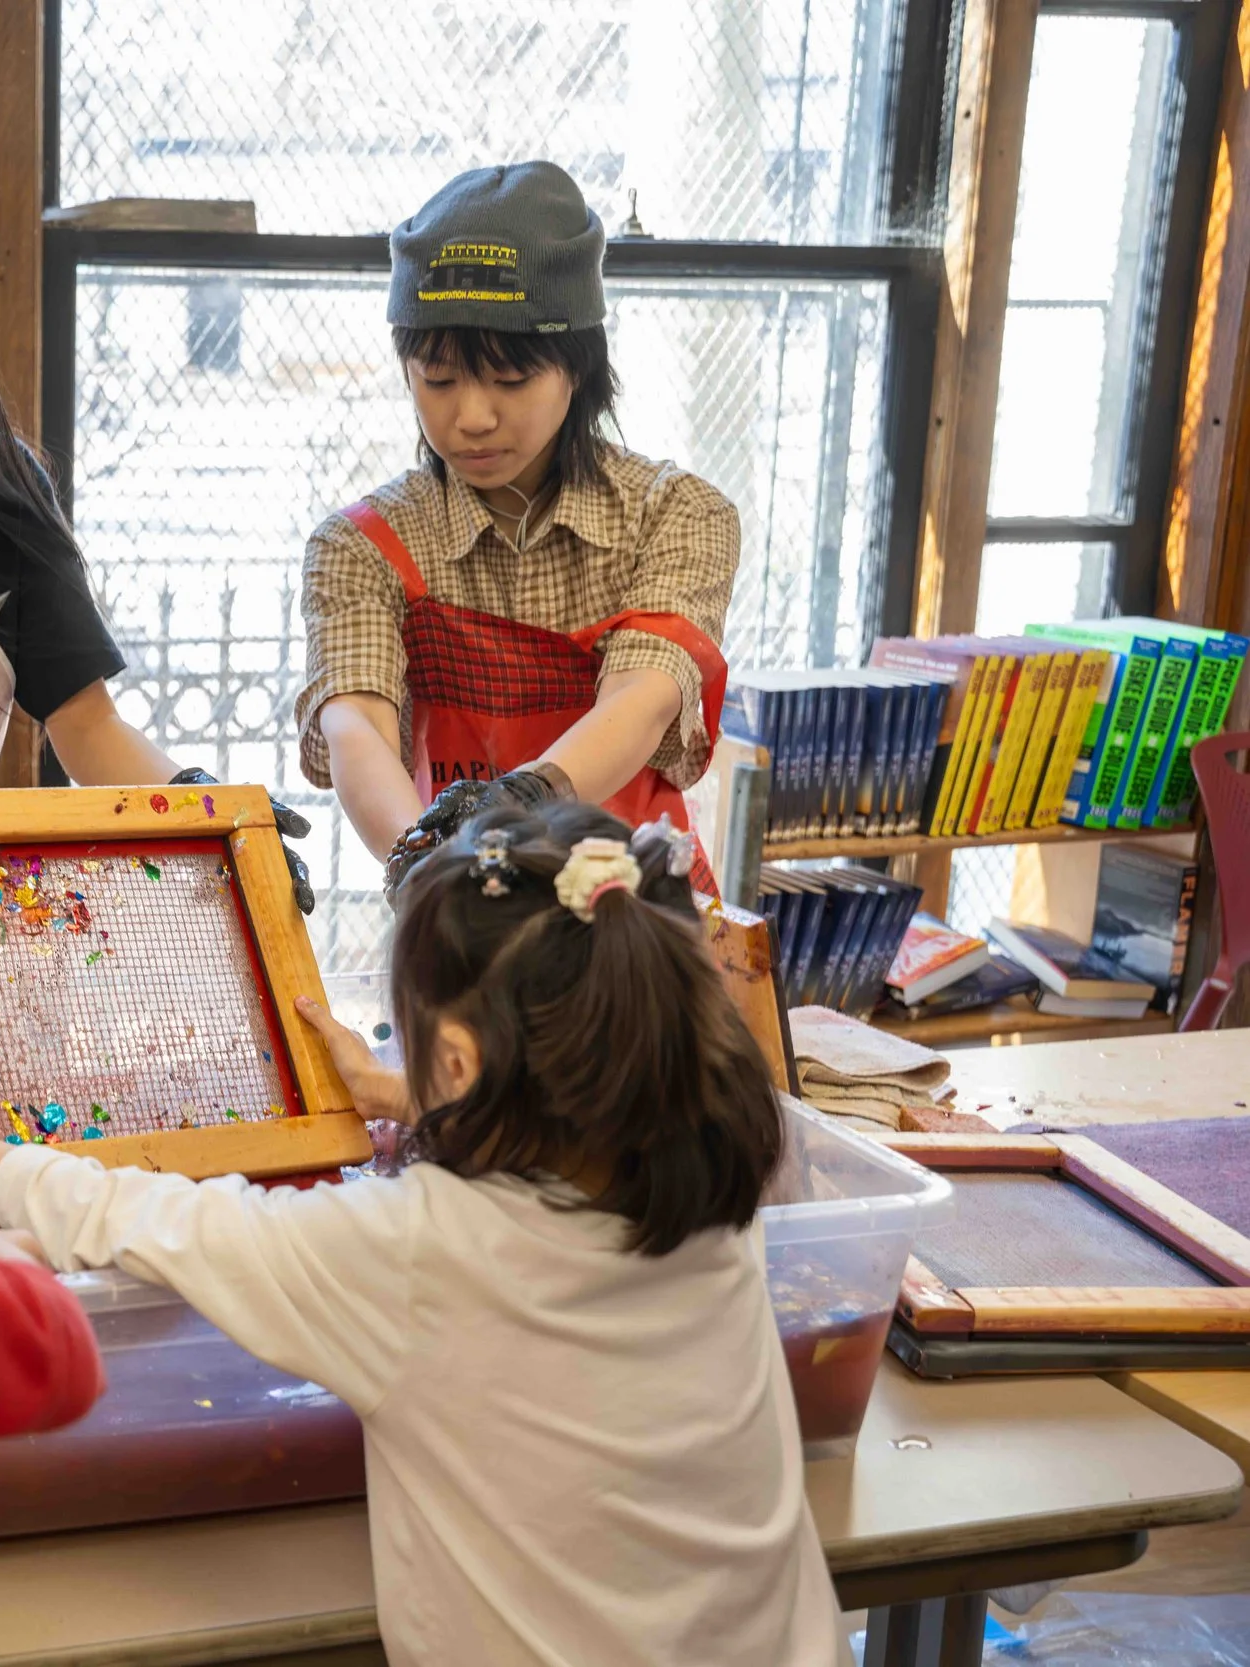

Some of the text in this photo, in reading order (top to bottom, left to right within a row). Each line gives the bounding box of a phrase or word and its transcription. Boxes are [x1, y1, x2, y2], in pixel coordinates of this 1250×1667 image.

[1124, 657, 1151, 695] FISKE
[1158, 658, 1186, 697] FISKE
[1195, 659, 1222, 697] FISKE
[1206, 658, 1239, 732] FISKE GUIDE
[1113, 696, 1139, 733] GUIDE
[1147, 697, 1174, 735] GUIDE
[1183, 697, 1209, 735] GUIDE
